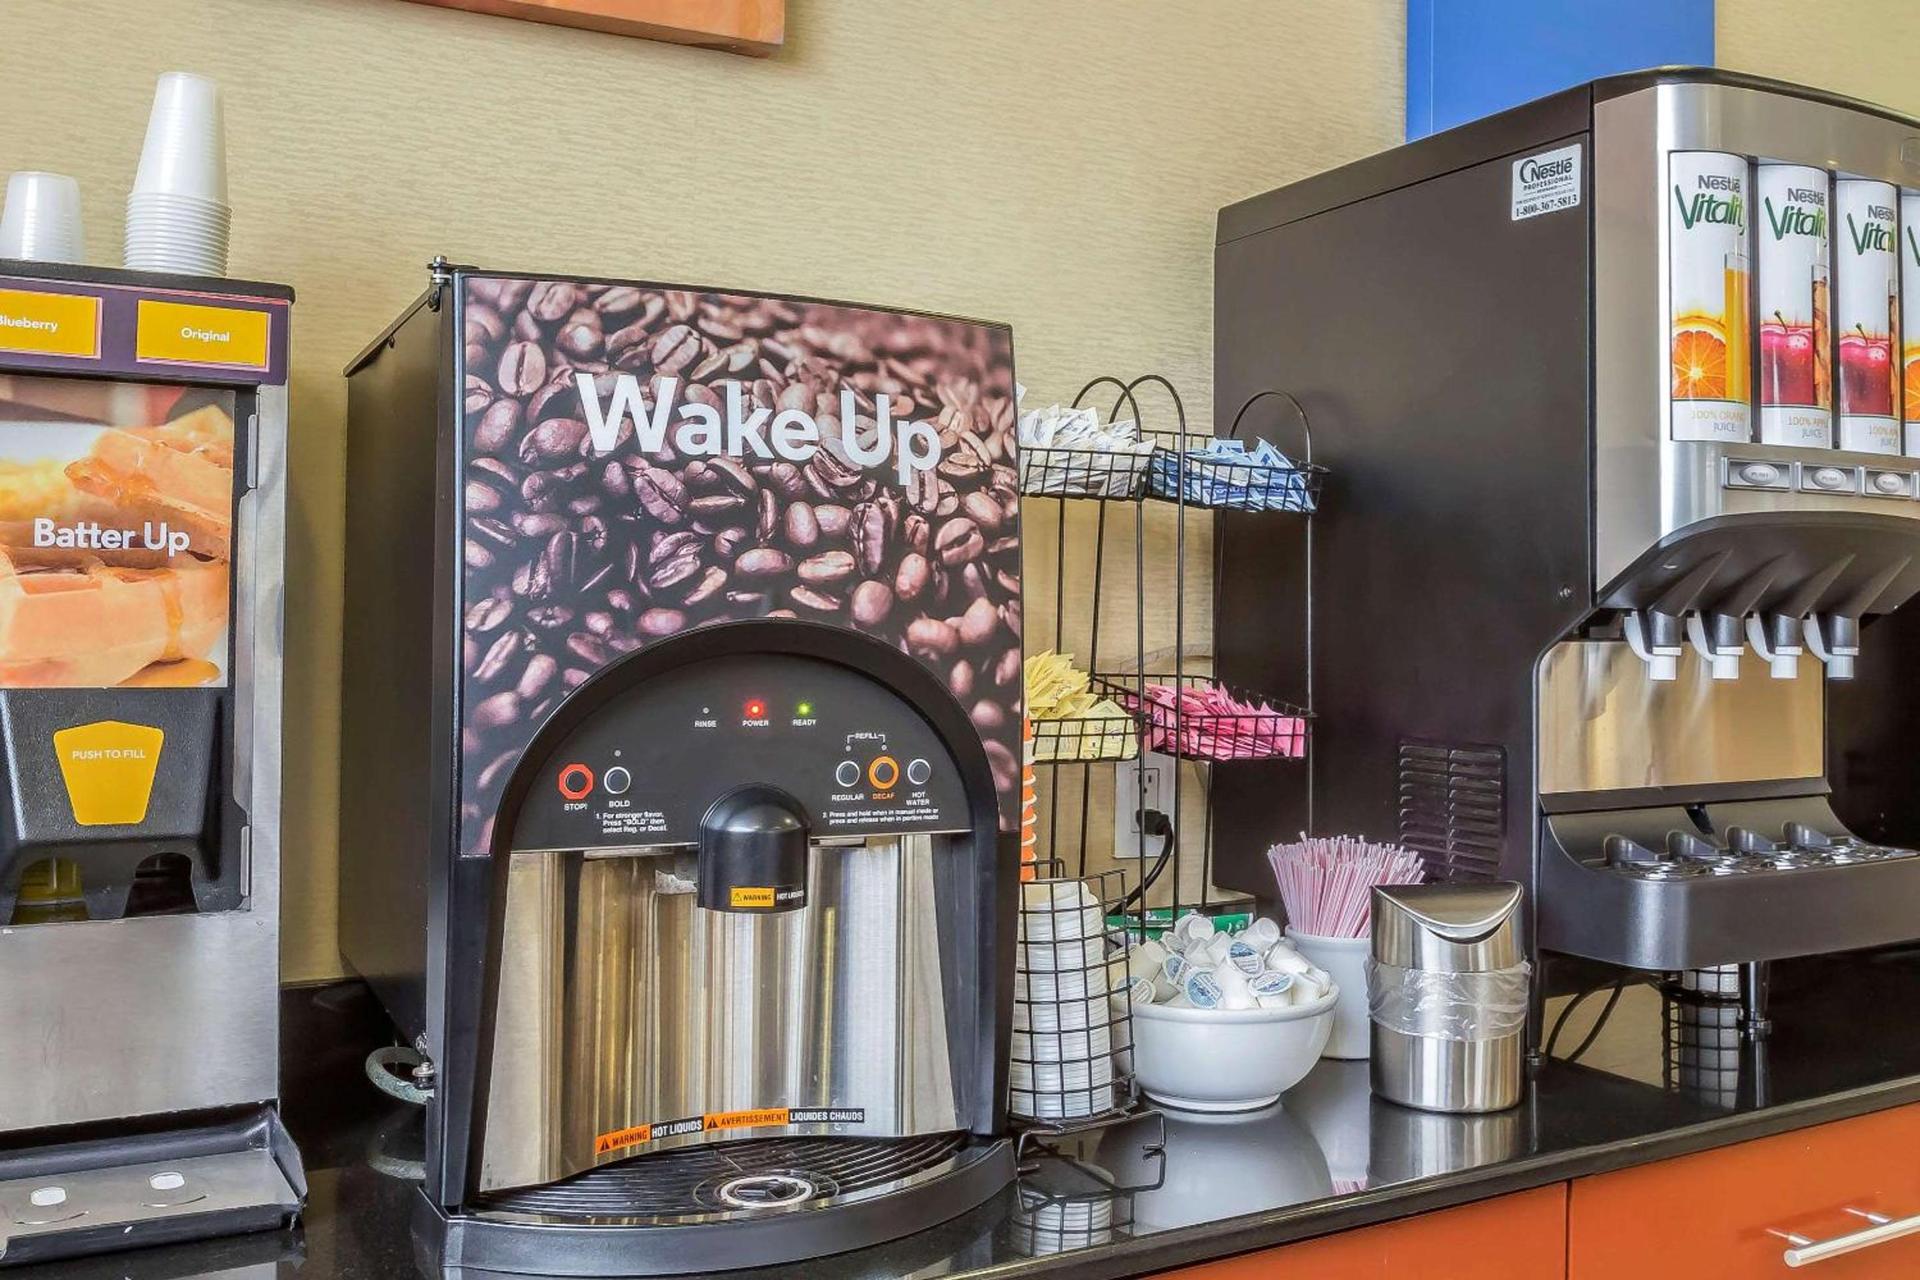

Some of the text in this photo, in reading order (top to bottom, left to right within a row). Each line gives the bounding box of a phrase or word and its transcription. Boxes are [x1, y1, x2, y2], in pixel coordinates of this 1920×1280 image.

[1523, 175, 1574, 191] PROFESSIONAL
[181, 327, 230, 343] Original
[575, 372, 942, 486] Wake Up
[1712, 422, 1737, 433] JUICE
[33, 517, 191, 557] Batter Up
[694, 720, 717, 728] RINSE
[742, 719, 769, 727] POWER
[72, 749, 146, 760] PUSH TO FILL
[831, 793, 865, 801] REGULAR
[872, 792, 896, 800] DECAF
[608, 800, 631, 808] BOLD
[615, 812, 643, 820] stronger
[743, 893, 772, 901] WARNING
[612, 1111, 864, 1147] WARNING HOT LIQUIDS AVERTISSEMENT LIQUIDES CHAUDS
